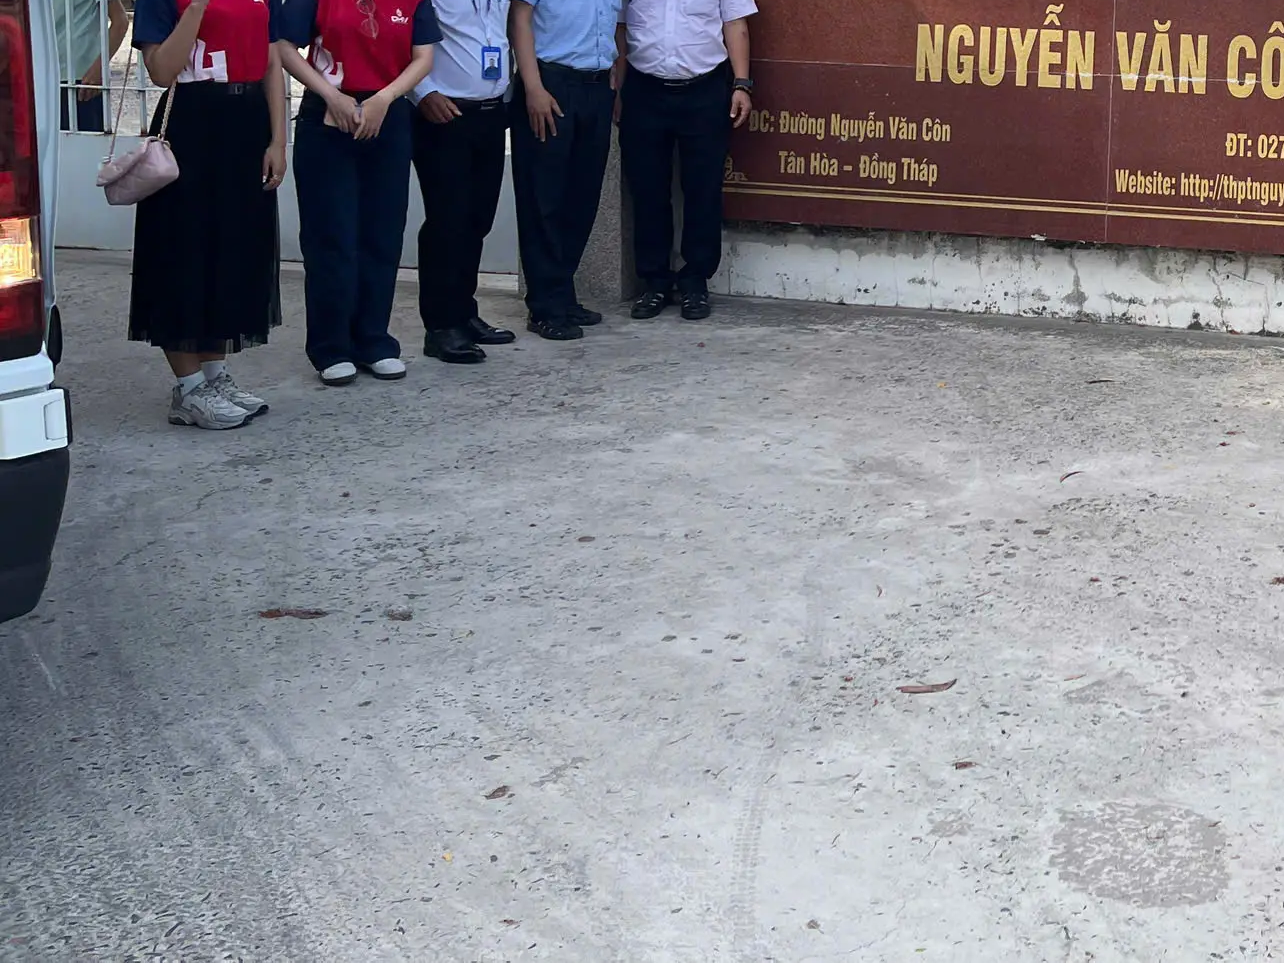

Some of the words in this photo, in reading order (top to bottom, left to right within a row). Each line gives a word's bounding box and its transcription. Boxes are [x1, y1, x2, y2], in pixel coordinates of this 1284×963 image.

[915, 3, 1095, 90] NGUYỄN
[1116, 19, 1209, 95] VĂN
[749, 109, 775, 133] ĐC:
[779, 111, 826, 140] Đường
[830, 111, 884, 143] Nguyễn
[888, 116, 917, 141] Văn
[921, 117, 951, 142] Côn
[1225, 132, 1253, 158] ĐT:
[778, 150, 805, 174] Tân
[810, 152, 839, 176] Hòa
[859, 153, 897, 185] Đồng
[901, 157, 938, 187] Tháp
[1115, 169, 1176, 196] Website:
